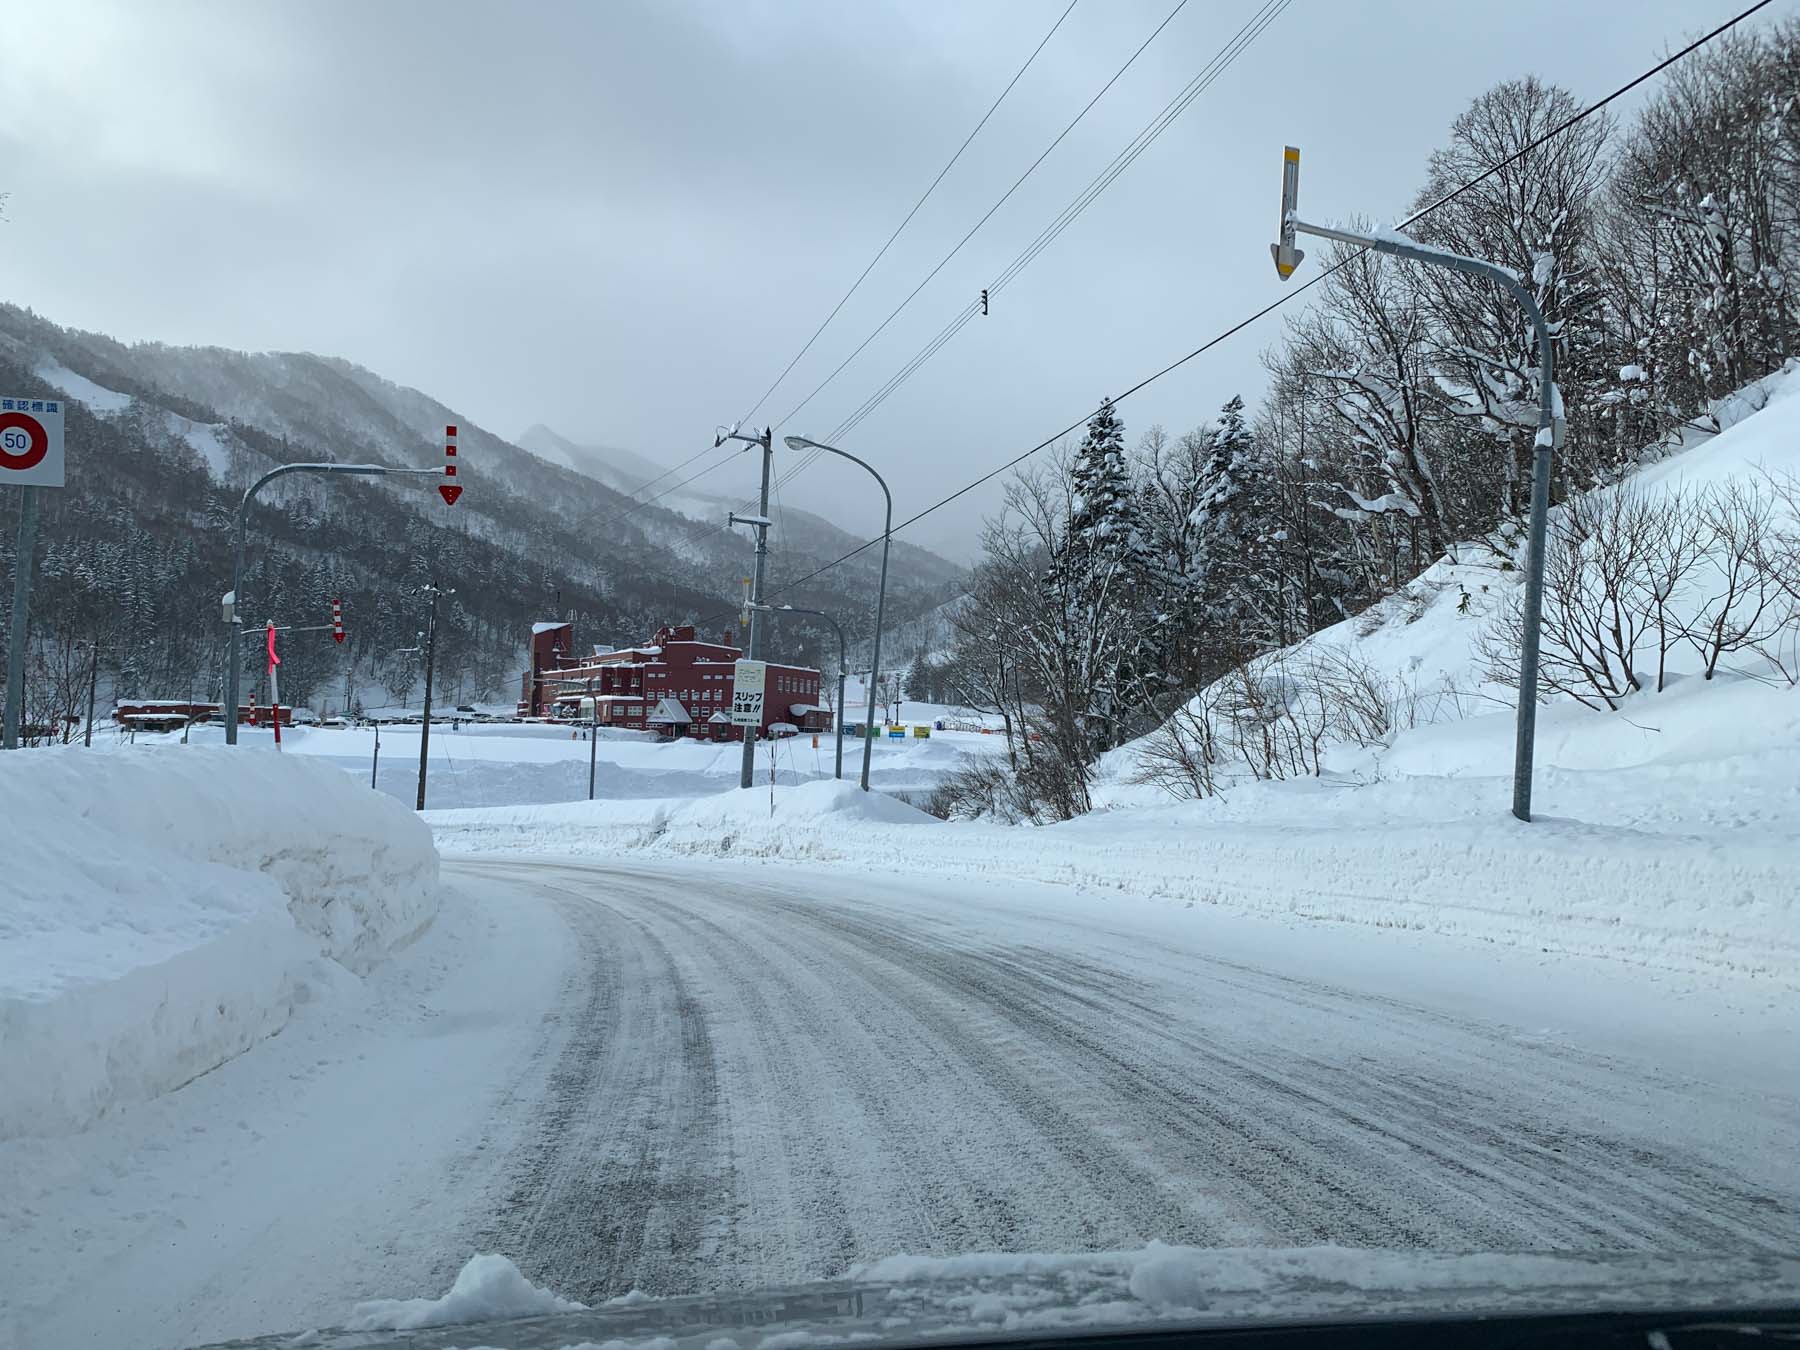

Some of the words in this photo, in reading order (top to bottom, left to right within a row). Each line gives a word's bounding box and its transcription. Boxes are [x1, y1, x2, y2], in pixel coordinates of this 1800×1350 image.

[2, 399, 58, 413] 確認標識
[5, 433, 26, 449] 50
[735, 692, 763, 702] スリップ
